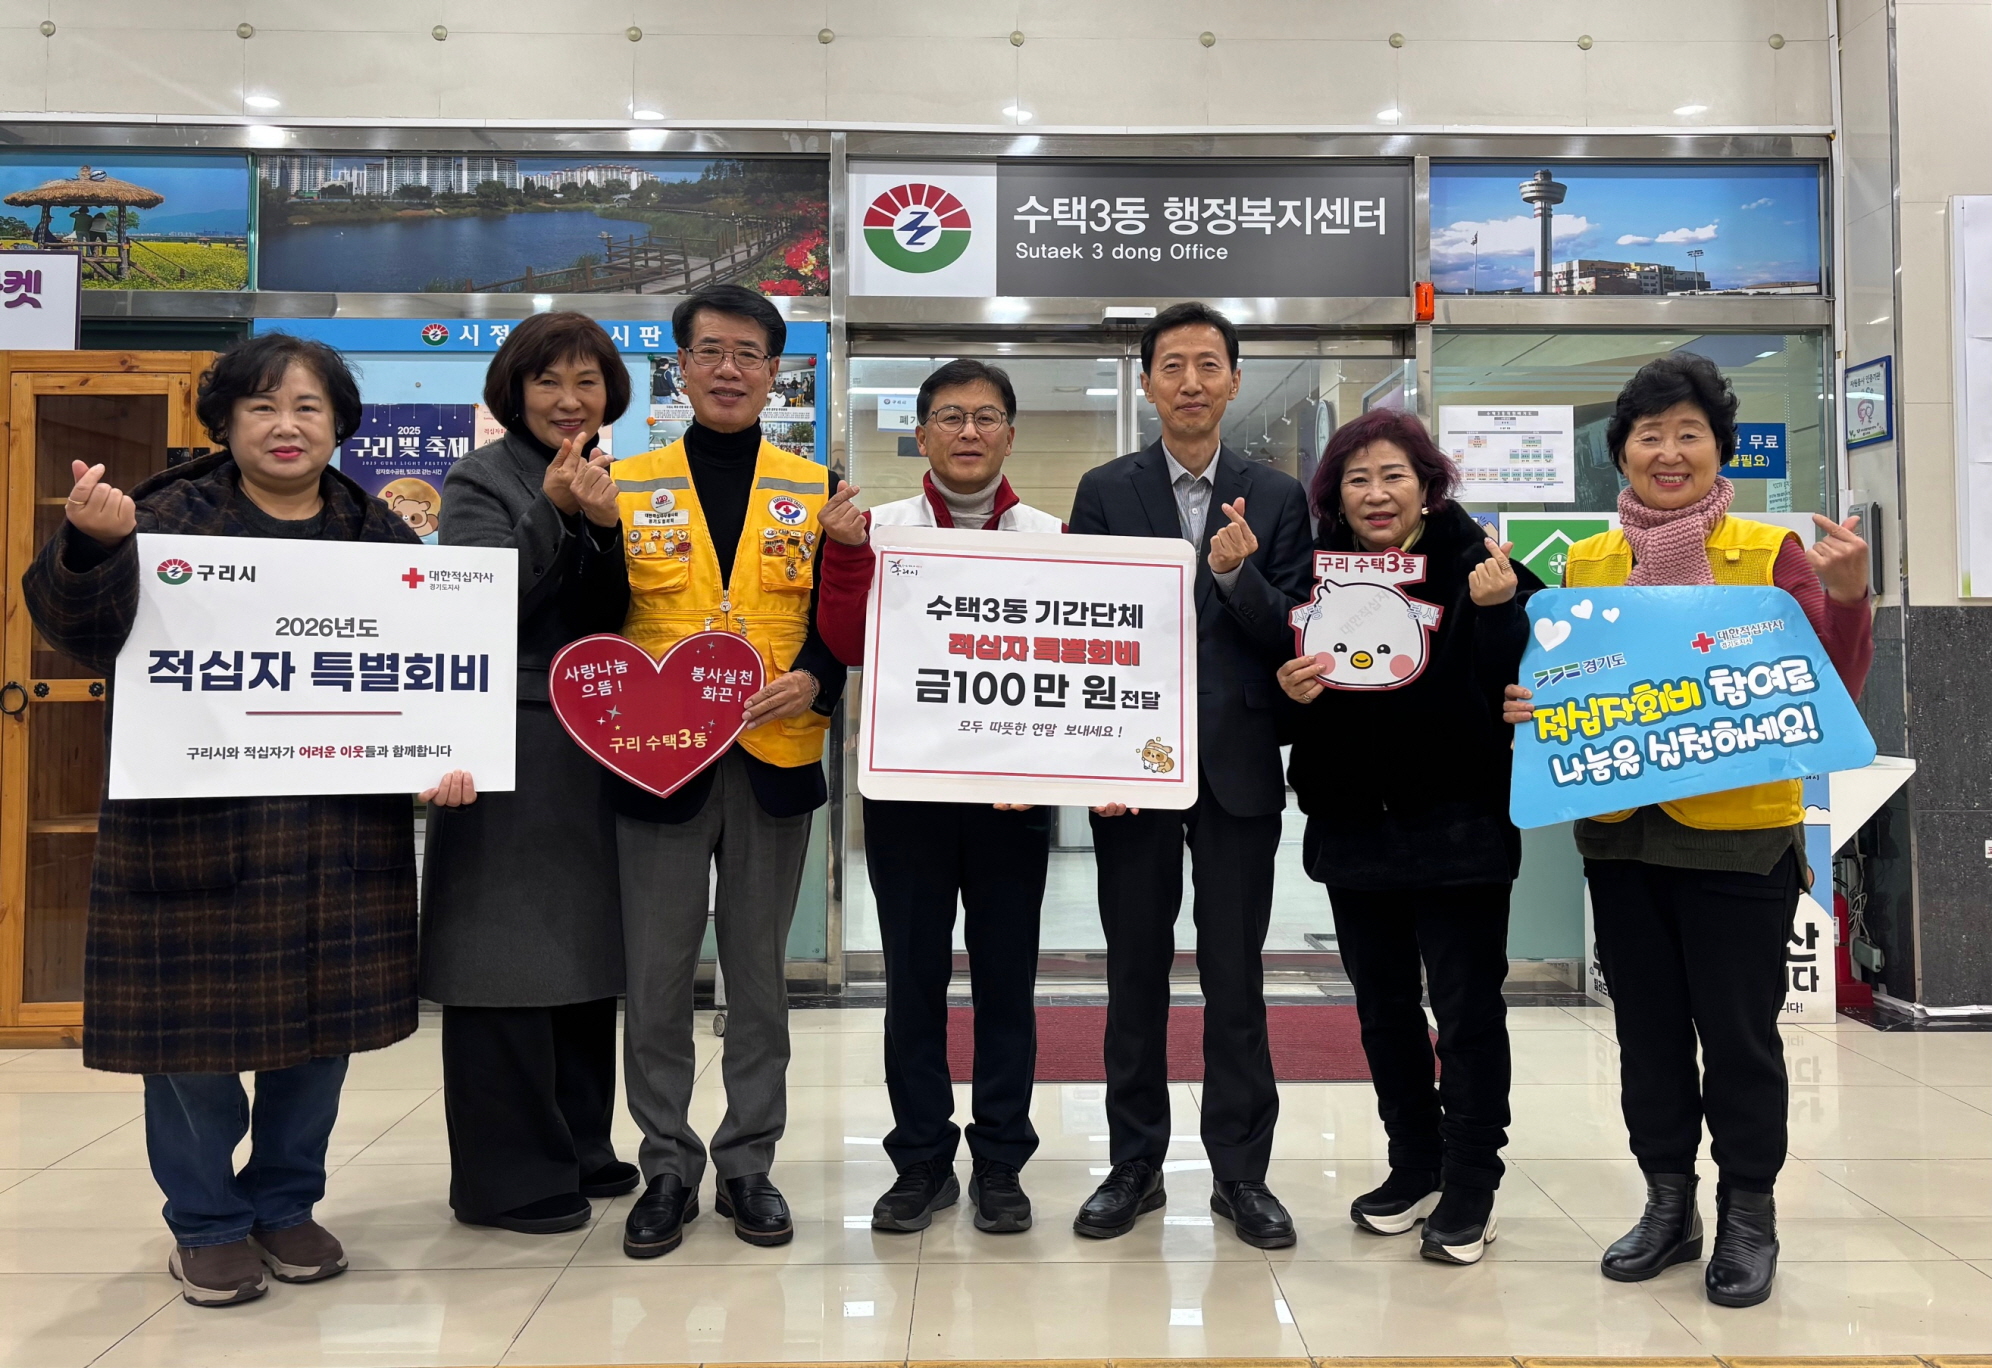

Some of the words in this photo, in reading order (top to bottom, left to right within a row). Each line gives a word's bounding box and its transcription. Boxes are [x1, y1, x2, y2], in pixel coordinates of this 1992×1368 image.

[1013, 195, 1150, 235] 수택3동
[1163, 196, 1386, 236] 행정복지센터
[1015, 242, 1083, 259] Sutaek
[1092, 243, 1104, 259] 3
[1112, 242, 1161, 262] dong
[1170, 243, 1228, 260] Office
[397, 426, 421, 435] 2025
[350, 436, 393, 458] 구리
[398, 436, 420, 458] 빛
[425, 436, 469, 458] 축제
[1749, 434, 1779, 450] 무료
[196, 564, 257, 583] 구리시
[1318, 557, 1349, 573] 구리
[1354, 553, 1417, 574] 수택3동
[429, 569, 494, 584] 대한적십자사
[429, 583, 460, 592] 경기도지사
[925, 595, 1028, 625] 수택3동
[1035, 599, 1144, 629] 기간단체
[275, 616, 380, 639] 2026년도
[1717, 618, 1784, 642] 대한적십자사
[948, 632, 1029, 662] 적십자
[1033, 636, 1141, 667] 특별회비
[147, 649, 296, 692] 적십자
[310, 651, 489, 693] 특별회비
[564, 658, 629, 683] 사랑나눔
[1582, 652, 1627, 676] 경기도
[690, 666, 754, 687] 봉사실천
[1532, 680, 1703, 743] 적십자회비
[1708, 658, 1816, 707] 참여로
[957, 720, 983, 733] 모두
[989, 721, 1027, 735] 따뜻한
[1032, 722, 1058, 737] 연말
[609, 735, 641, 754] 구리
[645, 728, 708, 752] 수택3동
[1551, 738, 1641, 785] 나눔을
[1649, 705, 1820, 767] 실천하세요!
[186, 746, 240, 761] 구리시와
[243, 745, 295, 760] 적십자가
[298, 745, 336, 759] 어려운
[340, 745, 389, 759] 이웃들과
[392, 744, 453, 758] 함께합니다
